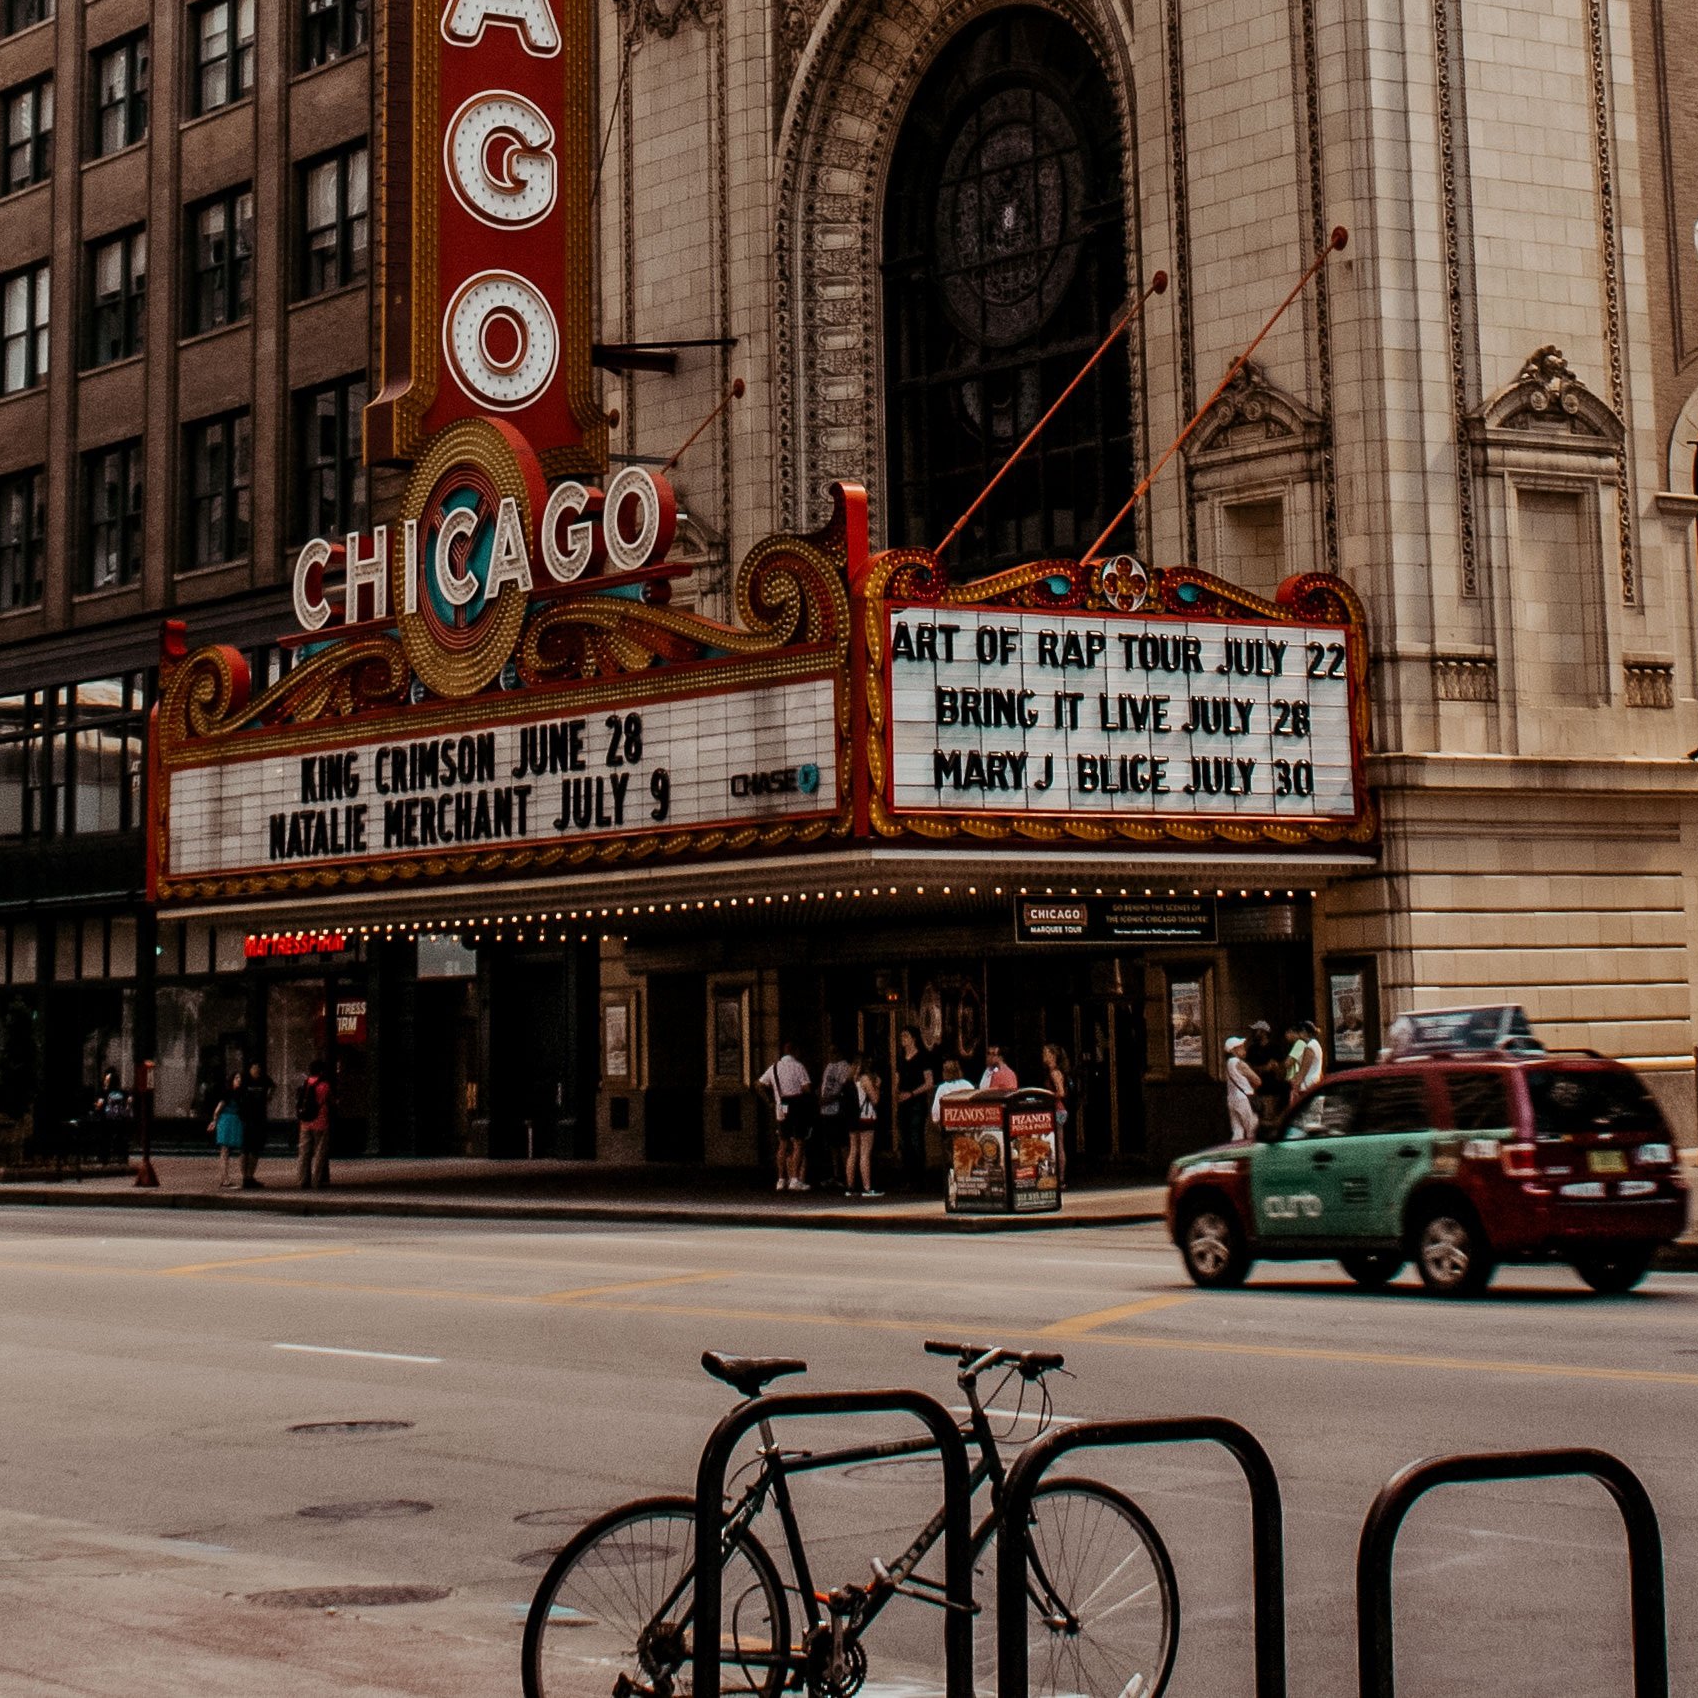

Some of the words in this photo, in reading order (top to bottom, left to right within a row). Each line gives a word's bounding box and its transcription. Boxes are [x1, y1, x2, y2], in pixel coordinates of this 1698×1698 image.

[293, 466, 663, 632] CHICAGO
[892, 622, 961, 663] ART
[975, 624, 1017, 665] OF
[1038, 628, 1107, 669] RAP
[1119, 632, 1204, 673] TOUR
[1217, 636, 1288, 677] JULY
[1306, 641, 1346, 681] 22
[936, 685, 1039, 728] BRING
[1054, 690, 1084, 731] IT
[1100, 692, 1171, 733] LIVE
[1182, 695, 1256, 736] JULY
[1272, 699, 1311, 738] 28
[300, 750, 360, 804] KING
[375, 733, 497, 796] CRIMSON
[512, 718, 587, 779] JUNE
[605, 712, 644, 767] 28
[933, 749, 1029, 791] MARY
[1035, 752, 1054, 791] J
[1077, 753, 1170, 794] BLIGE
[1183, 755, 1256, 796] JULY
[1275, 758, 1314, 798] 30
[731, 766, 798, 798] CHASE
[269, 803, 368, 861] NATALIE
[383, 784, 532, 849] MERCHANT
[553, 772, 631, 832] JULY
[650, 767, 671, 822] 9
[1030, 908, 1080, 920] CHICAGO
[1105, 915, 1119, 923] THE
[1119, 915, 1145, 923] ICONIC
[1145, 915, 1177, 923] CHICAGO
[1124, 904, 1150, 912] BEHIND
[1151, 904, 1165, 912] THE
[1030, 925, 1063, 934] MARQUEE
[1065, 925, 1083, 934] TOUR
[944, 1108, 984, 1121] PIZANO'S
[1011, 1113, 1052, 1125] PIZANO'S
